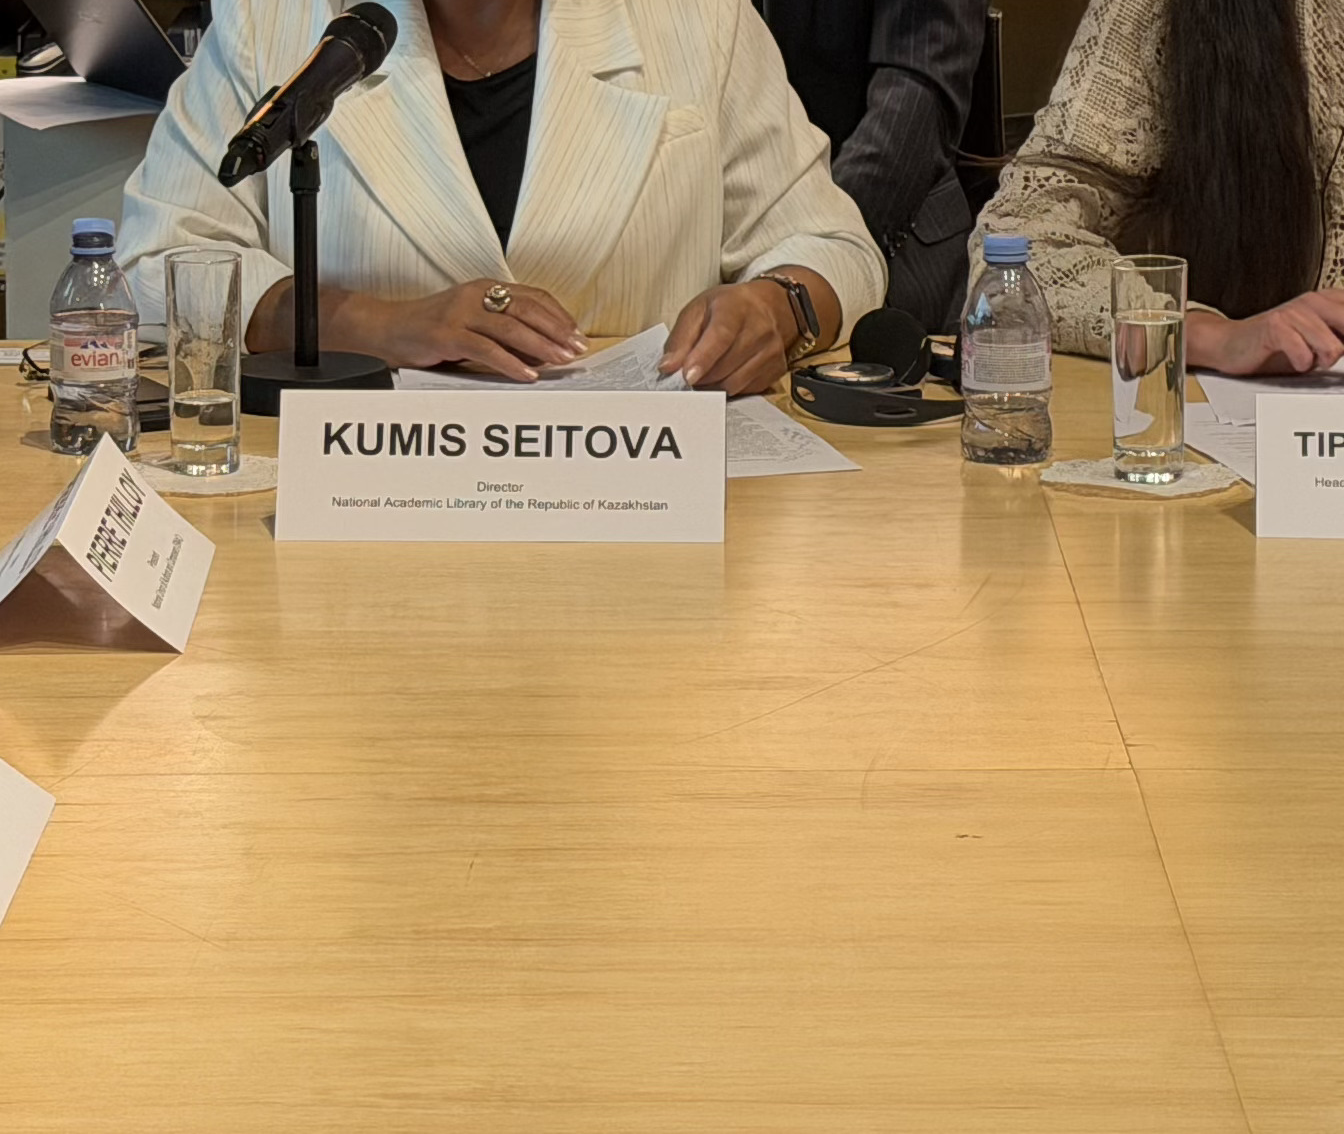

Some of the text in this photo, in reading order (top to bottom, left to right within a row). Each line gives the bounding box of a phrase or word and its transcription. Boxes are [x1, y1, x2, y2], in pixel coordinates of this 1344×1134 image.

[71, 352, 118, 367] evian
[322, 422, 682, 459] KUMIS SEITOVA
[477, 481, 524, 493] Director
[332, 496, 668, 512] National Academic Library of the Republic of Kazakhstan
[86, 467, 147, 583] PIERRE THILLOY
